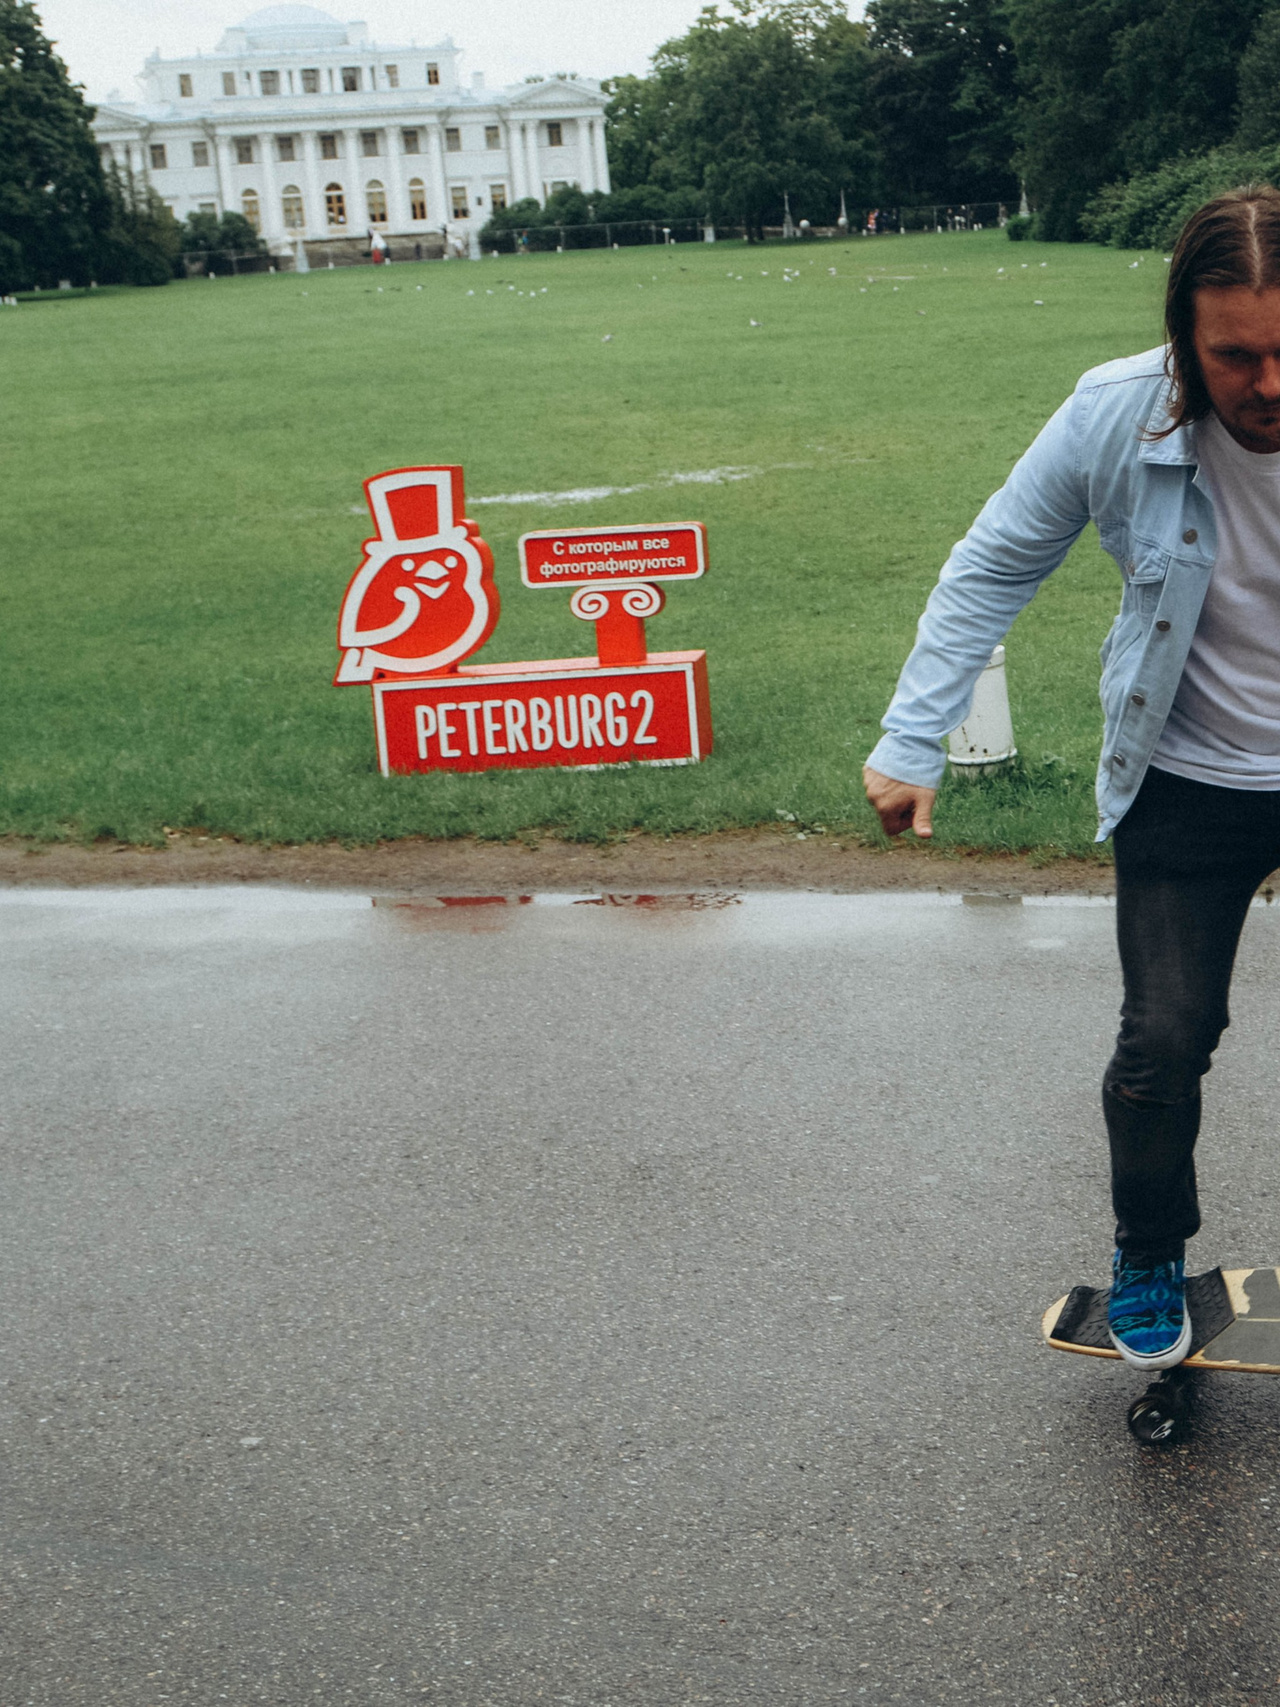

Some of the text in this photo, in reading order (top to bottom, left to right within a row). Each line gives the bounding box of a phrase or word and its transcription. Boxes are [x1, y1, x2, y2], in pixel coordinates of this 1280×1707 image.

[552, 536, 670, 556] С которым все
[539, 554, 687, 578] фотографируются
[414, 689, 658, 760] PETERBURG2
